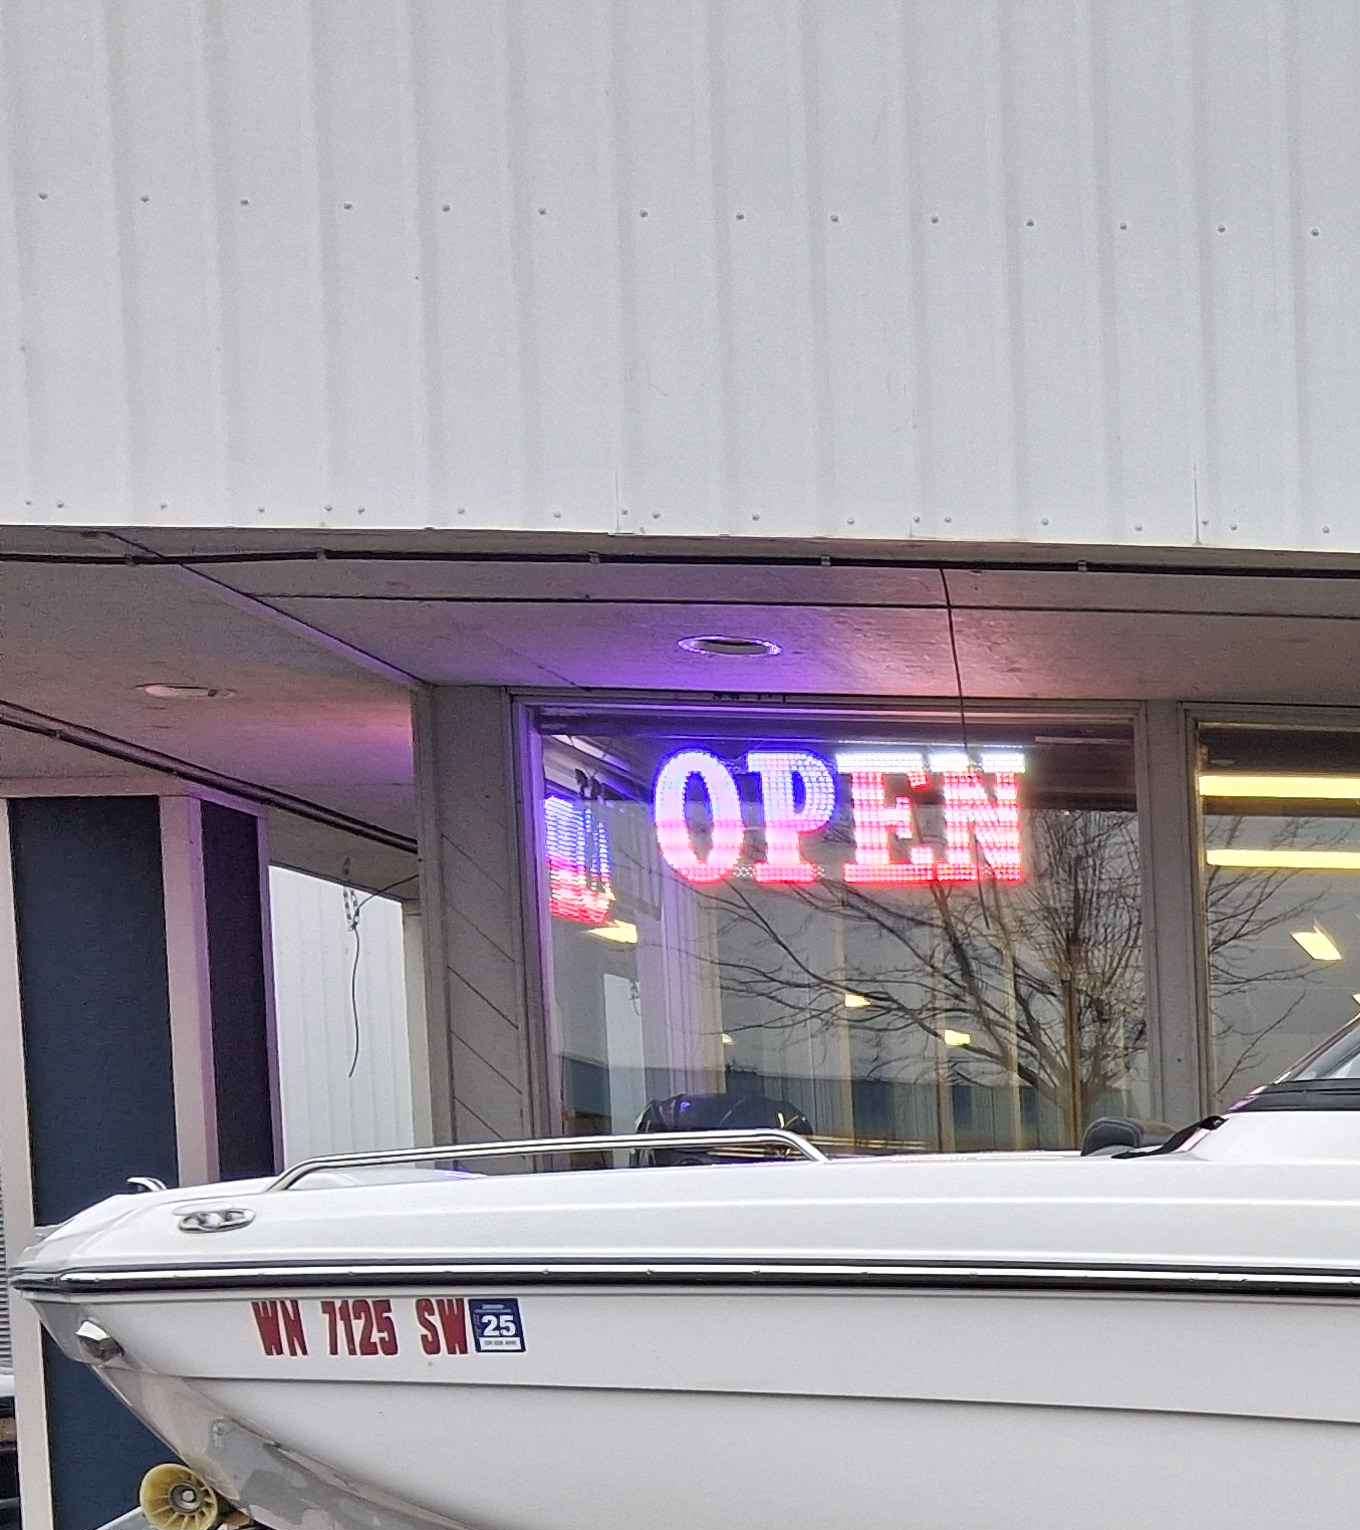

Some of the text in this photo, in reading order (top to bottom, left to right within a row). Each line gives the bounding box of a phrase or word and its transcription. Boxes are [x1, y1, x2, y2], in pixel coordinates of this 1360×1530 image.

[655, 748, 1025, 883] OPEN
[251, 1298, 469, 1357] WN 7125 SW
[482, 1315, 517, 1337] 25
